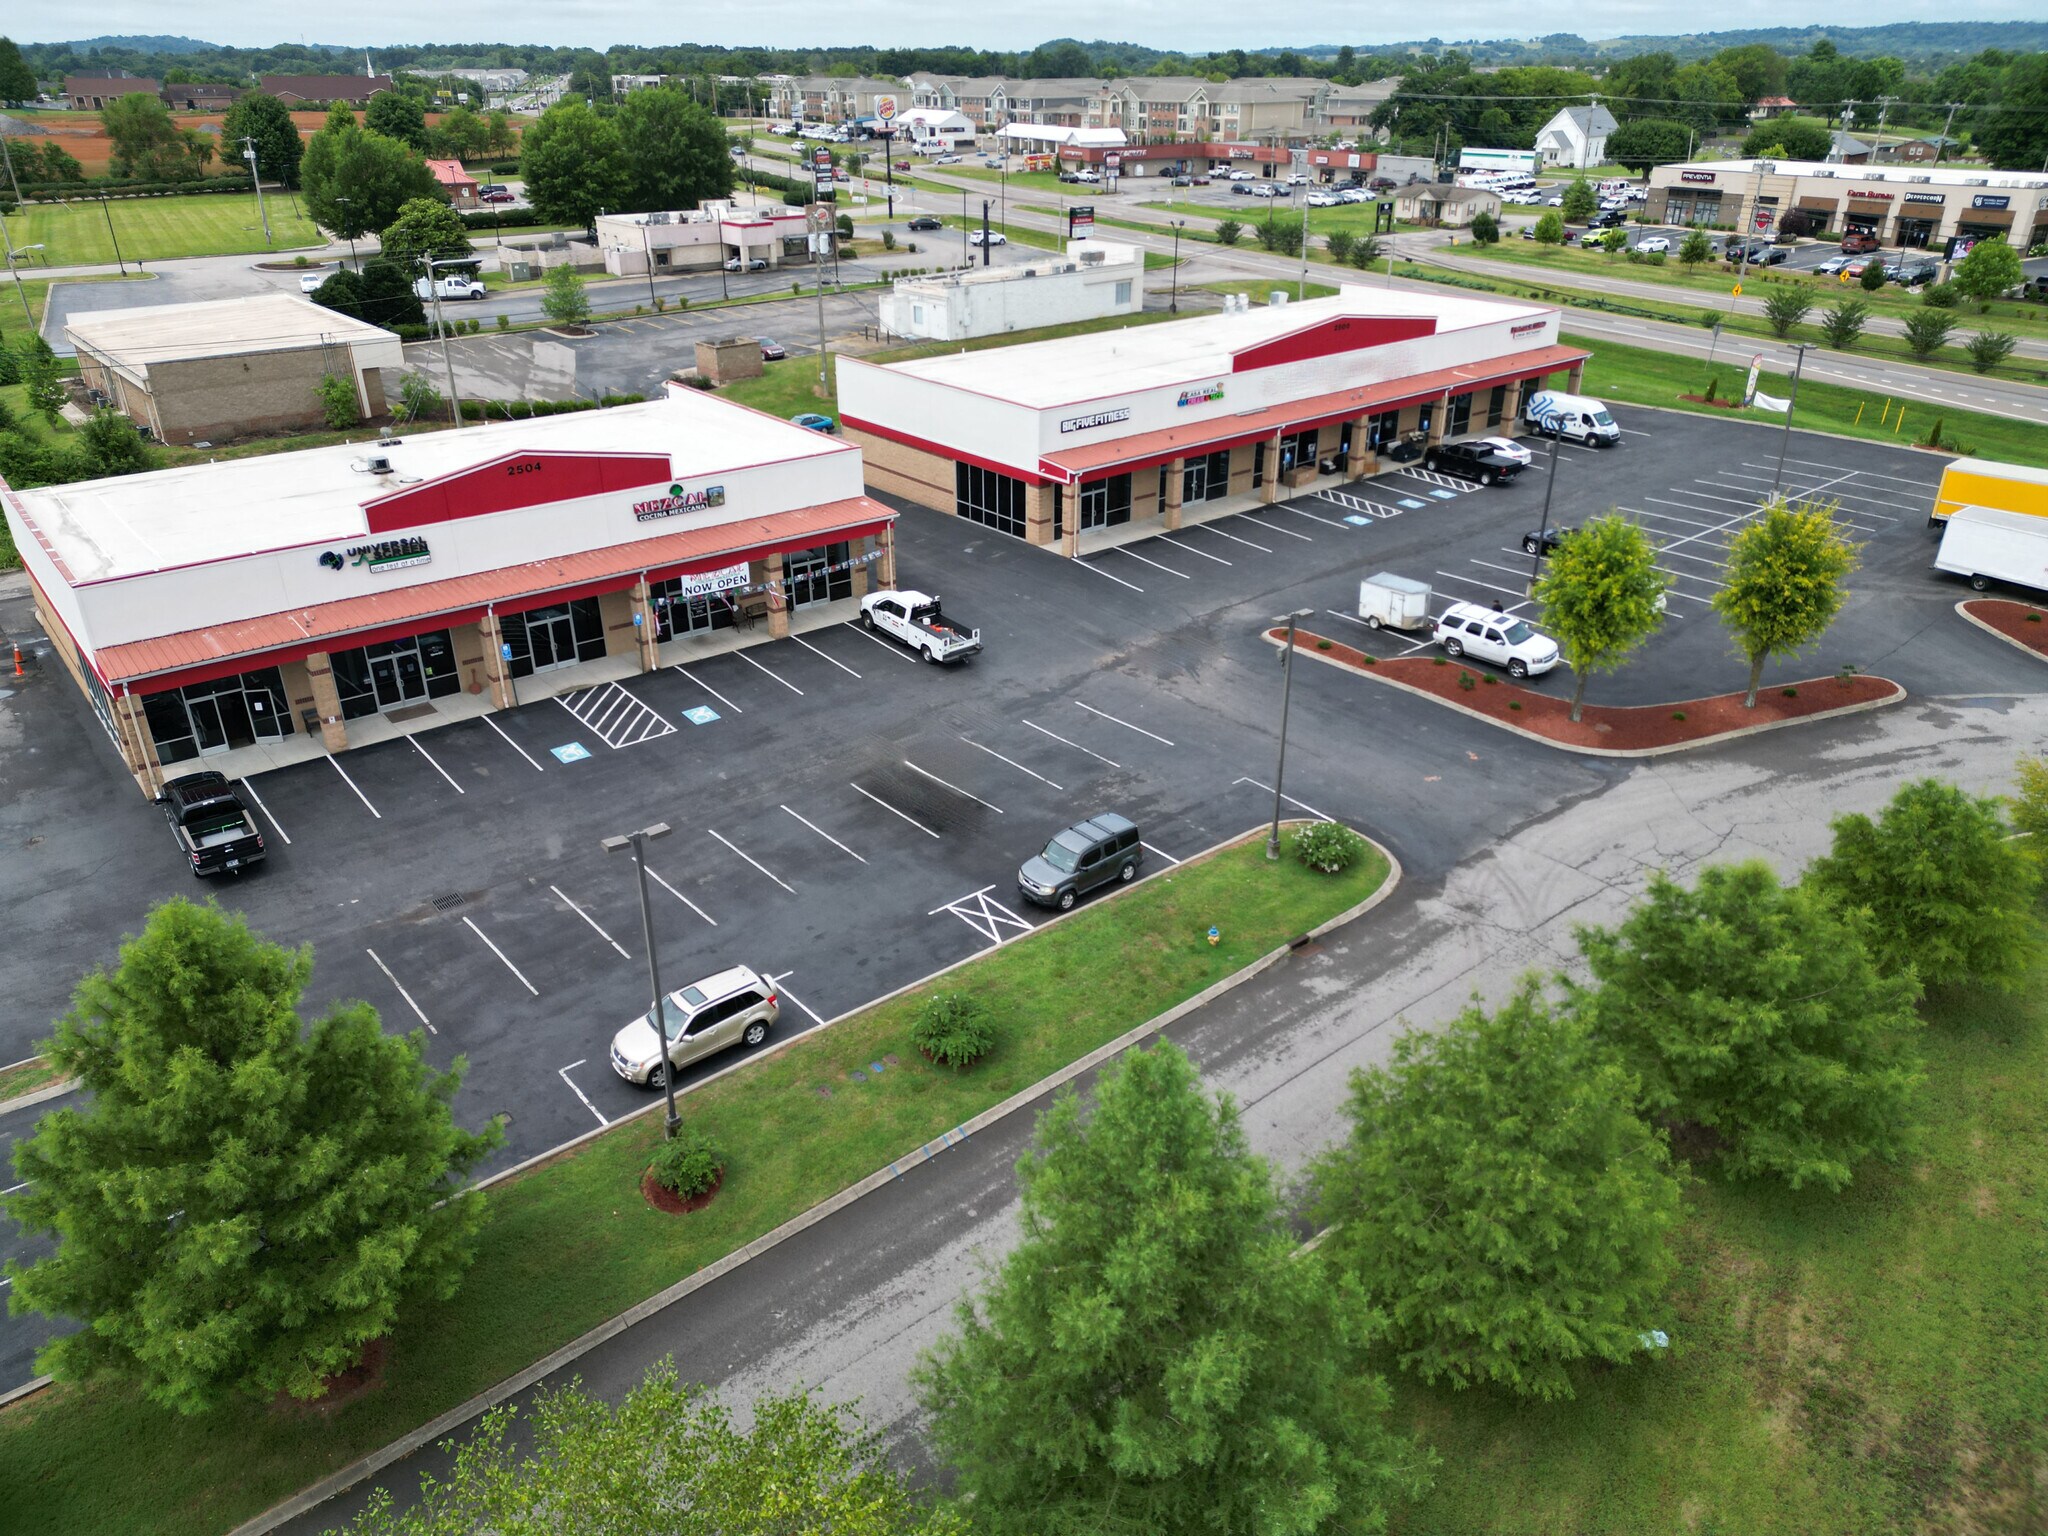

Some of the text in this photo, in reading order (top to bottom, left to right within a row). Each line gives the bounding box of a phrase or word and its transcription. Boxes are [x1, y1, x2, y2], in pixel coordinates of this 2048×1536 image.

[929, 139, 948, 147] FedEx
[1847, 189, 1895, 200] Farm Bureau
[1062, 409, 1130, 432] BIG FIVE FITNESS
[507, 462, 541, 476] 2504
[633, 491, 709, 514] MEZCAL
[639, 503, 706, 521] COCINA MEXICANA
[346, 536, 427, 557] UNIVERSAL
[374, 543, 429, 560] SCREEN
[685, 574, 747, 595] NOW OPEN
